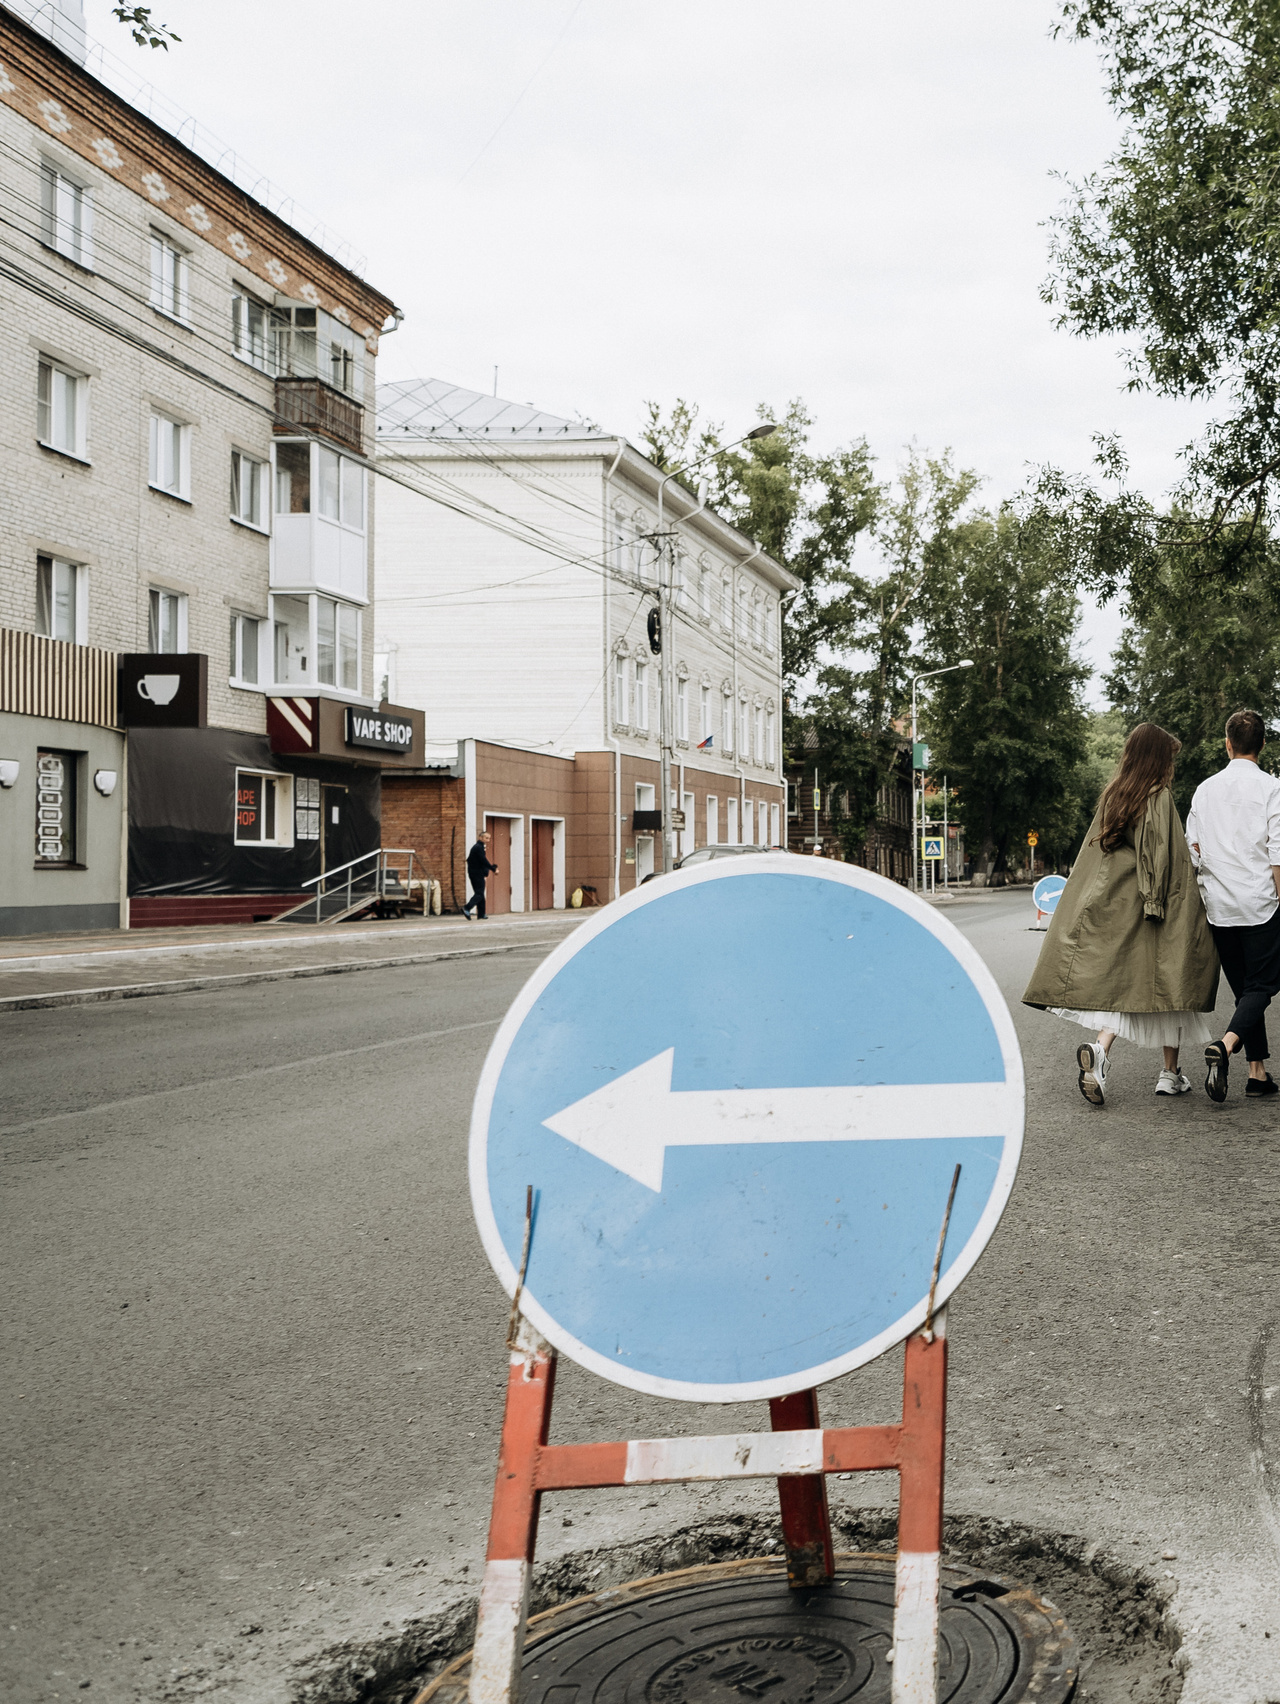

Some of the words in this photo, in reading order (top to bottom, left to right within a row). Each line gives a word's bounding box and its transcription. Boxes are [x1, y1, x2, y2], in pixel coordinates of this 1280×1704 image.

[353, 717, 381, 741] VAPE
[384, 721, 412, 745] SHOP
[237, 789, 255, 805] APE
[236, 811, 256, 826] HOP
